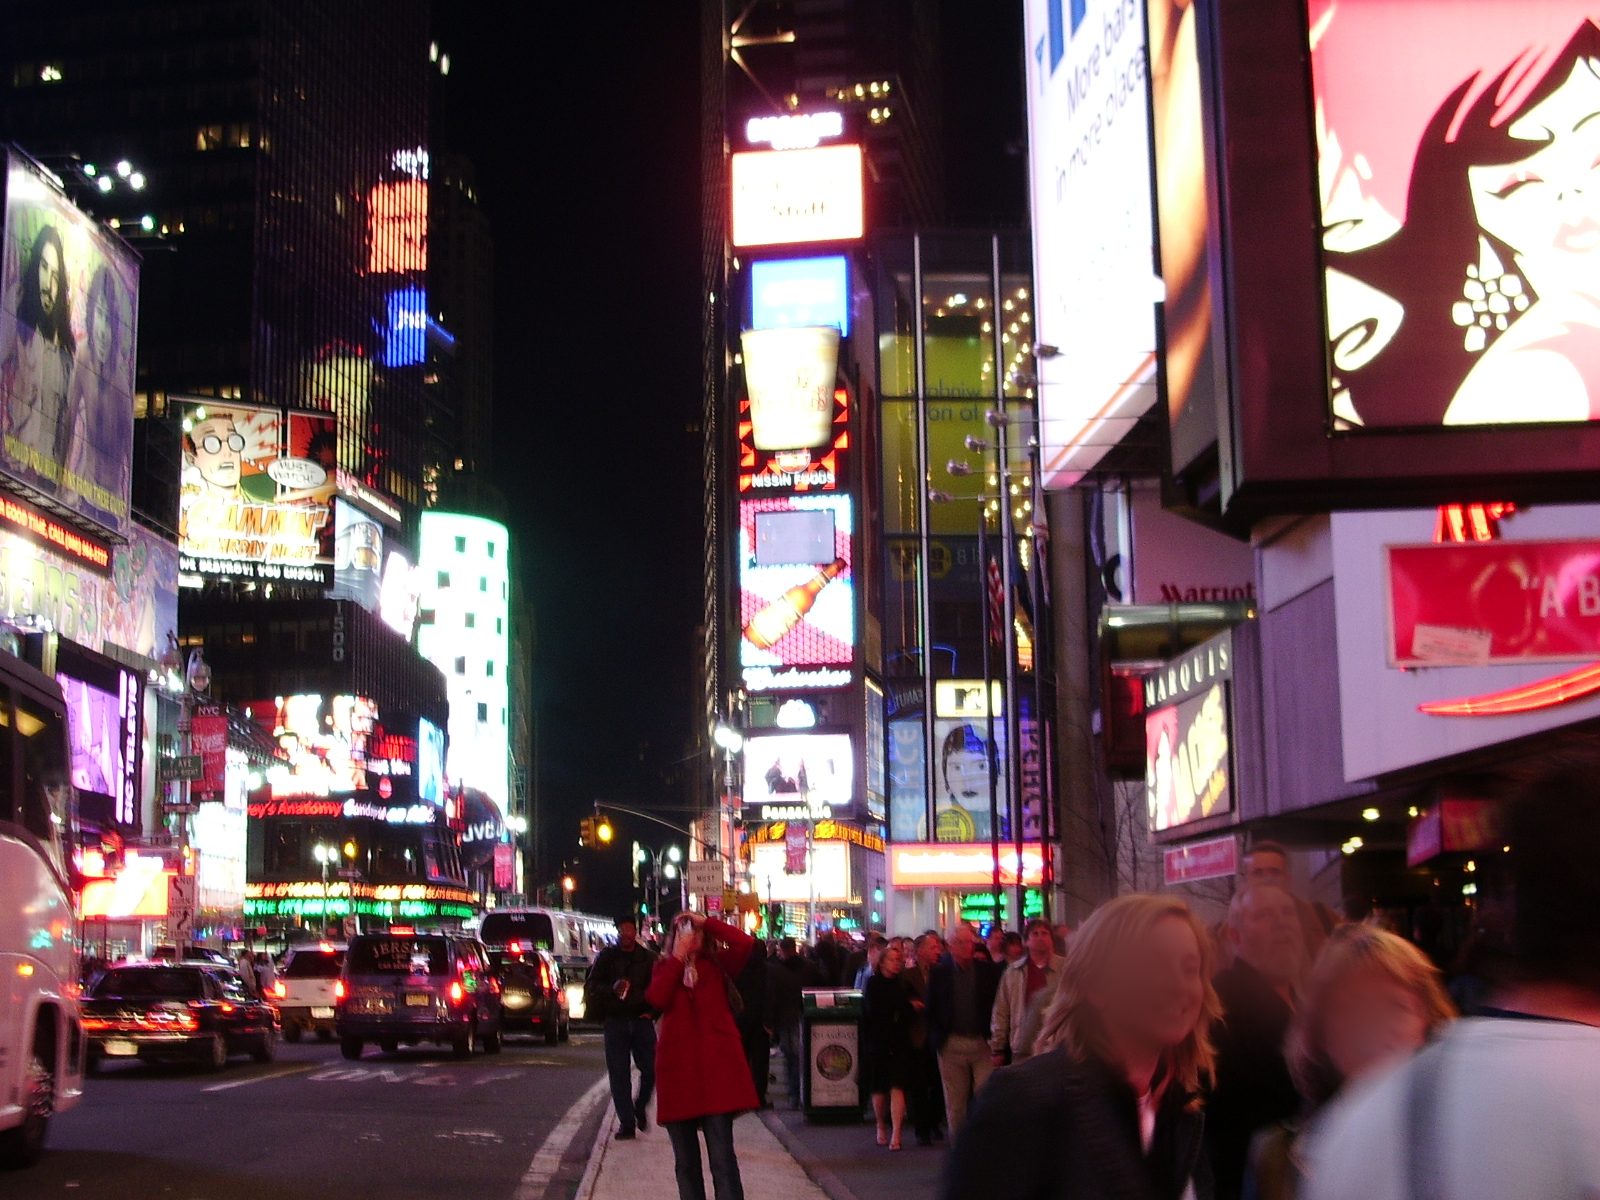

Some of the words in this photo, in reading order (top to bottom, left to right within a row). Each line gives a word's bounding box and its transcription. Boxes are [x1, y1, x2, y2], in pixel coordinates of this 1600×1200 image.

[751, 474, 792, 487] NISSIN
[795, 470, 835, 485] FOODS
[5, 501, 28, 527] GOOD
[48, 522, 65, 547] CALL
[179, 556, 197, 571] WE
[200, 559, 255, 577] DESTROY!
[257, 563, 281, 579] YOU
[283, 568, 325, 583] ENJOY!
[1146, 642, 1228, 707] MARQUIS
[198, 705, 220, 715] NYC
[278, 800, 343, 817] Anatomy
[462, 820, 495, 843] JVC
[256, 900, 277, 915] THE
